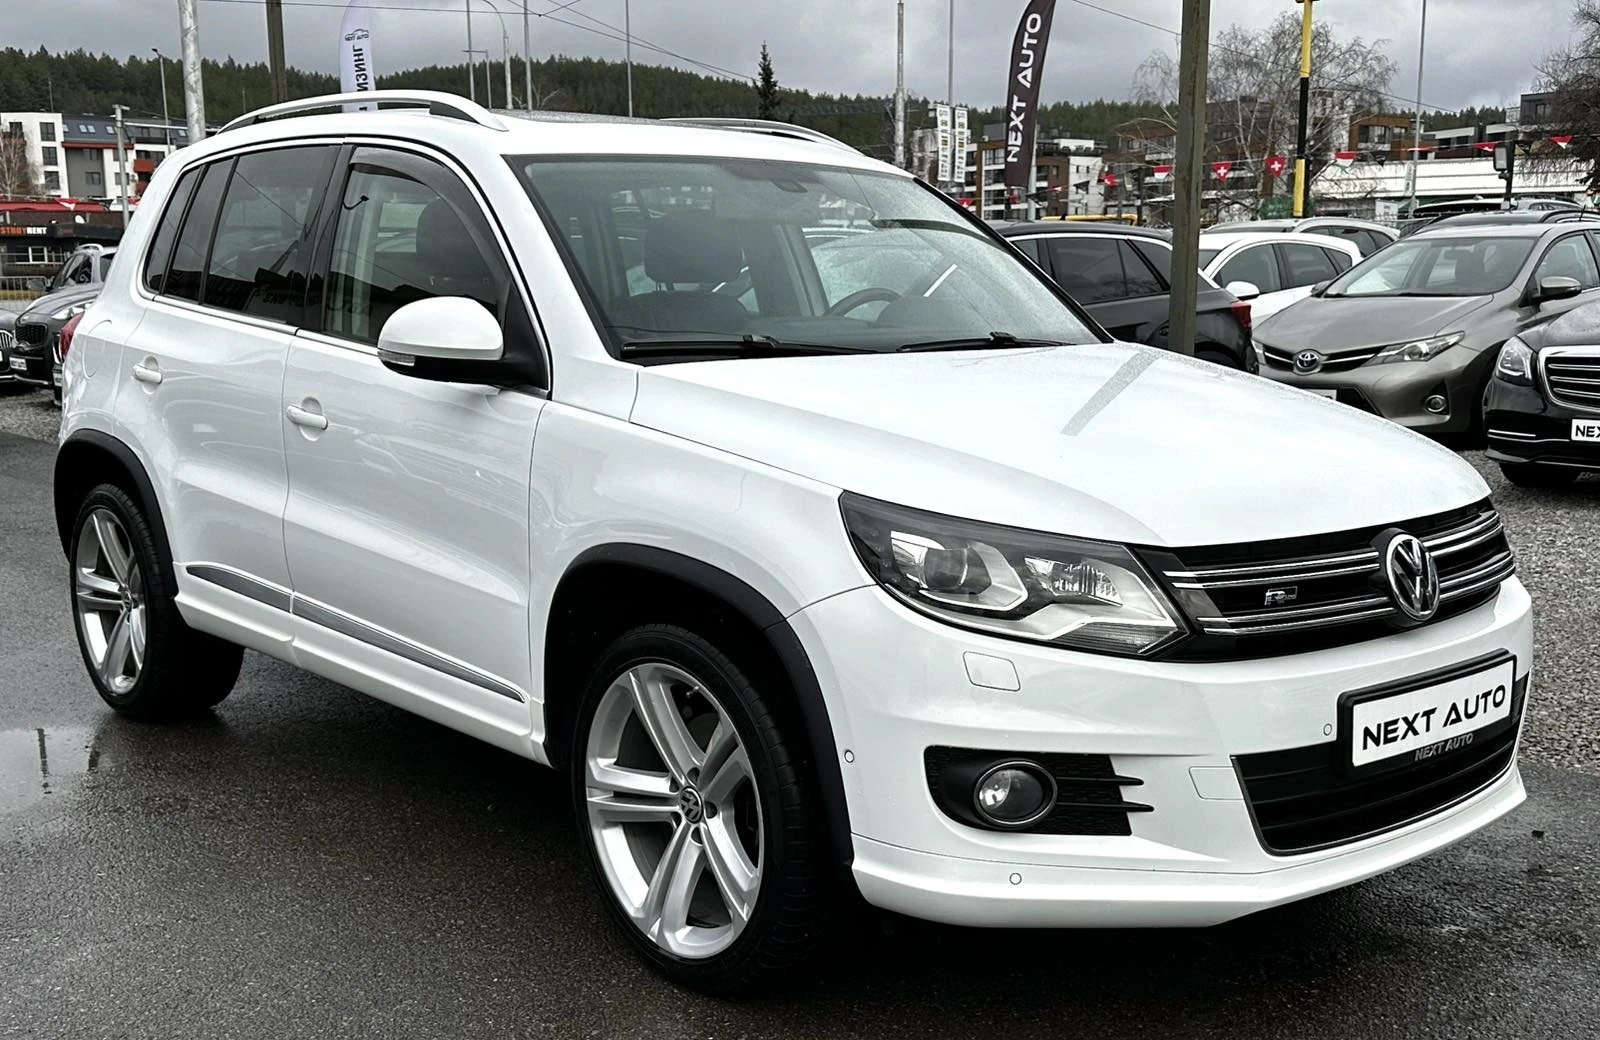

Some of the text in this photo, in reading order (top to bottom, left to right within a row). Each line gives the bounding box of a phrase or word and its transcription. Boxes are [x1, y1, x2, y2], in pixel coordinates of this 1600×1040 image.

[357, 33, 369, 41] AUTO
[353, 45, 369, 111] ИЗИНГ
[1006, 13, 1042, 163] NEXT AUTO
[1362, 684, 1506, 750] NEXT AUTO
[1414, 732, 1474, 761] NEXT AUTO
